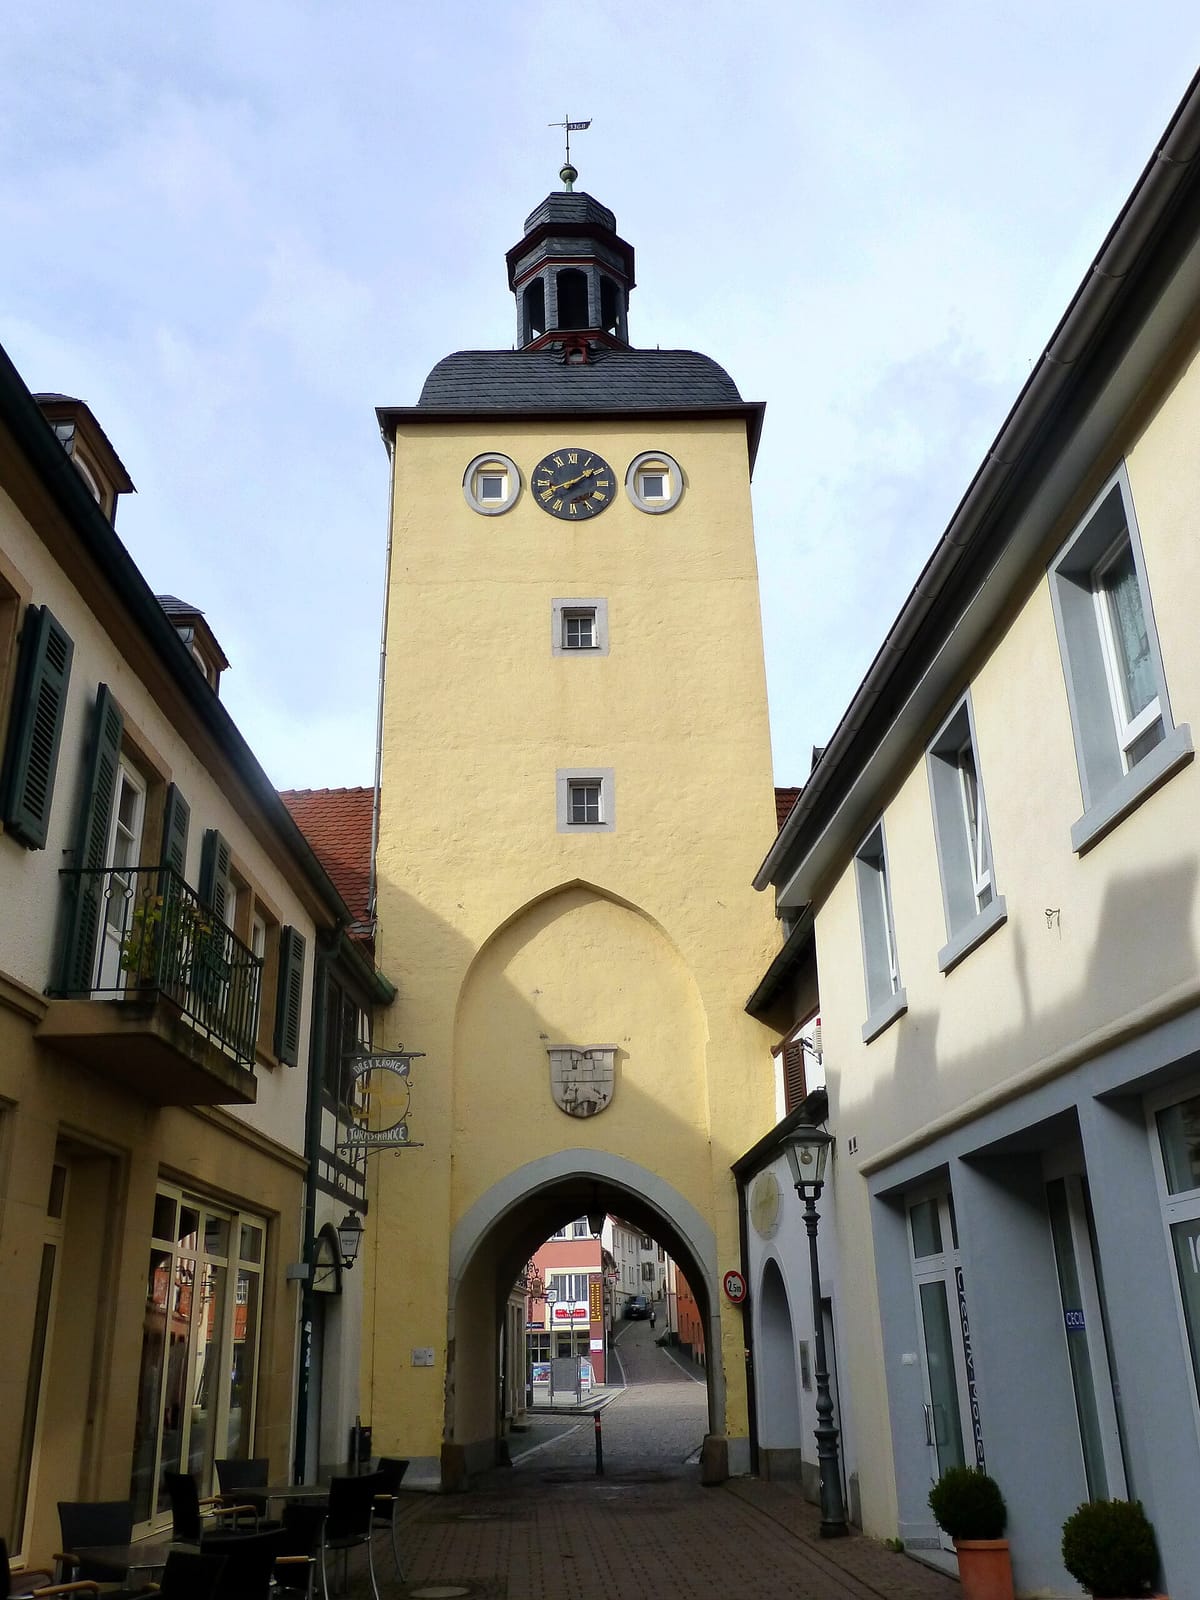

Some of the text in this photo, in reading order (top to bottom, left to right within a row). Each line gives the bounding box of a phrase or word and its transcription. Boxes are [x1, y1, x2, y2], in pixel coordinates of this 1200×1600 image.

[553, 456, 565, 468] XI
[568, 453, 578, 464] XII
[584, 457, 592, 467] I
[541, 466, 554, 476] X
[593, 467, 605, 476] II
[537, 479, 550, 487] IX
[552, 499, 564, 512] VII
[569, 503, 577, 514] VI
[584, 500, 593, 511] V
[352, 1058, 407, 1074] DREY KRONEN
